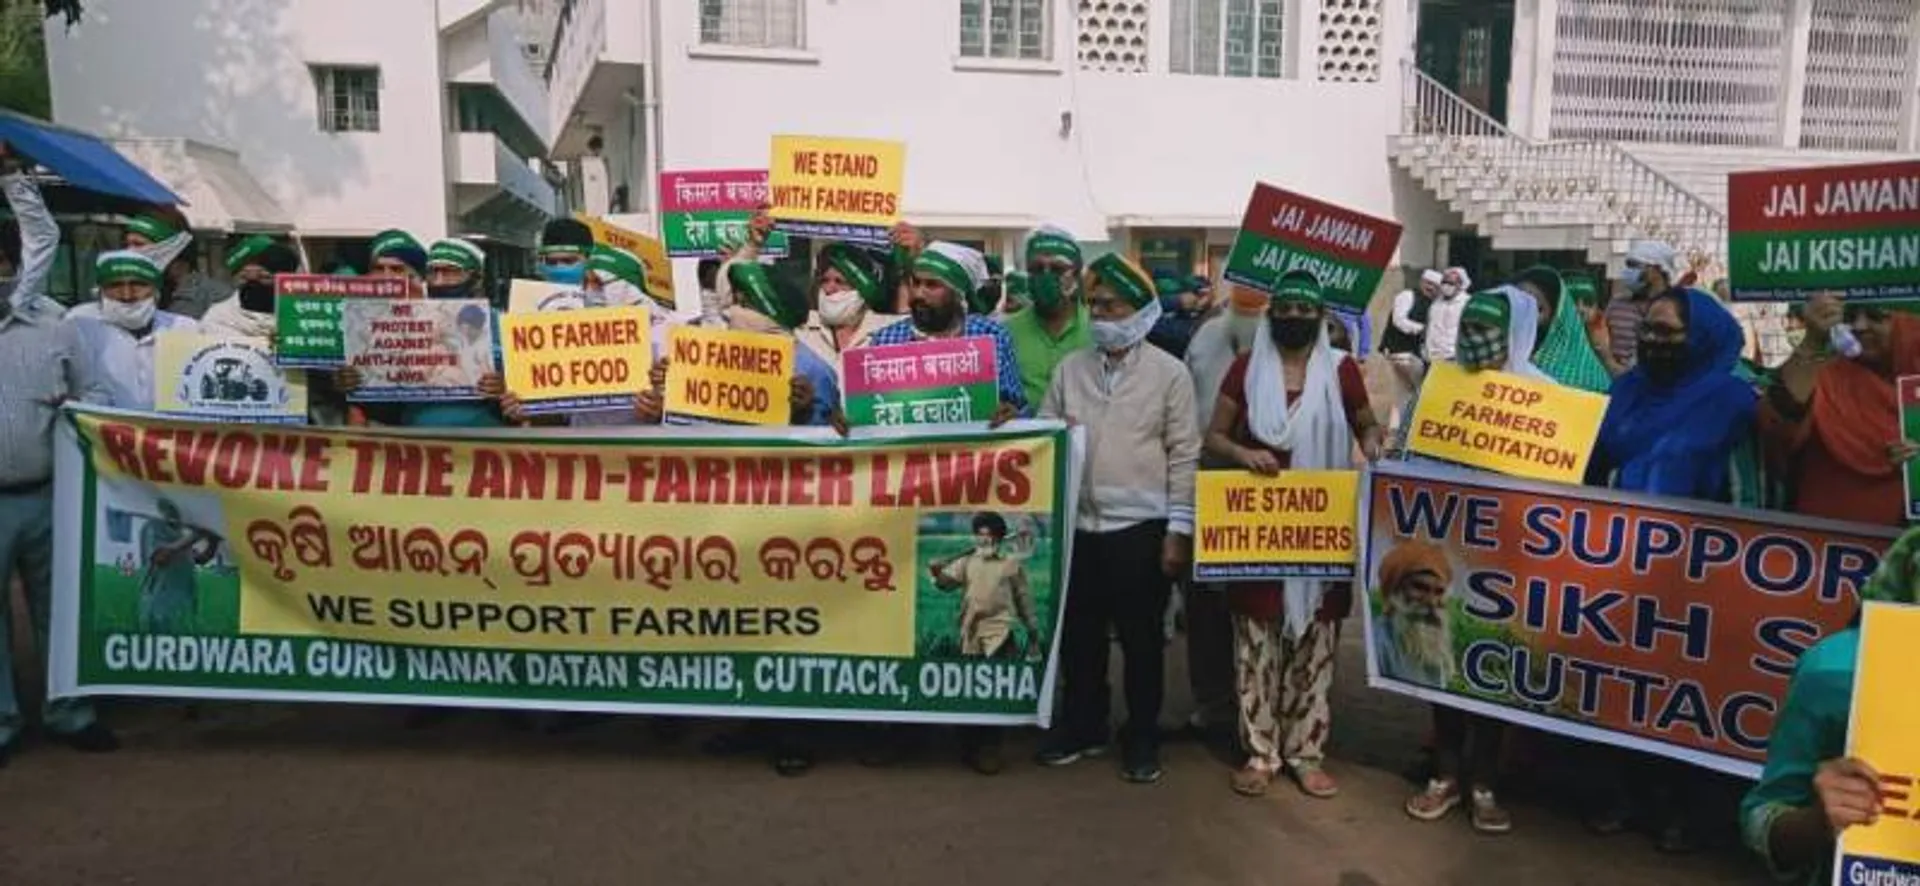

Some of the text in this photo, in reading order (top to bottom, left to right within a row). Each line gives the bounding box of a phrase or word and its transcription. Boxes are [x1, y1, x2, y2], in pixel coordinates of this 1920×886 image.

[793, 151, 878, 179] WE STAND
[674, 177, 720, 206] किसान
[771, 185, 896, 216] WITH FARMERS
[1763, 177, 1920, 217] JAI JAWAN
[1271, 203, 1375, 252] JAI JAWAN
[1252, 243, 1286, 271] JAI
[1288, 251, 1360, 290] KISHAN
[1758, 234, 1920, 273] JAI KISHAN
[371, 320, 433, 333] PROTEST
[391, 304, 412, 315] WE
[373, 338, 433, 350] AGAINST
[512, 319, 641, 351] NO FARMER
[386, 370, 425, 382] LAWS
[532, 358, 630, 388] NO FOOD
[674, 338, 782, 376] NO FARMER
[861, 342, 979, 384] किसान बचाओ
[686, 379, 769, 413] NO FOOD
[909, 387, 971, 425] बचाओ
[1481, 382, 1543, 407] STOP
[1450, 400, 1558, 438] FARMERS
[1420, 419, 1577, 471] EXPLOITATION
[101, 424, 1033, 507] REVOKE THE ANTI-FARMER LAWS
[1226, 487, 1329, 513] WE STAND
[246, 504, 896, 591] କୃଷି ଆଇନ୍ ପ୍ରତ୍ୟାହାର କରନ୍ତୁ
[1201, 525, 1352, 551] WITH FARMERS
[1387, 485, 1879, 603] WE SUPPOR
[308, 593, 822, 636] WE SUPPORT FARMERS
[1462, 570, 1822, 677] SIKH S
[105, 634, 1038, 703] GURDWARA GURU NANAK DATAN SAHIB, CUTTACK, ODISHA
[1463, 639, 1779, 753] CUTTAC
